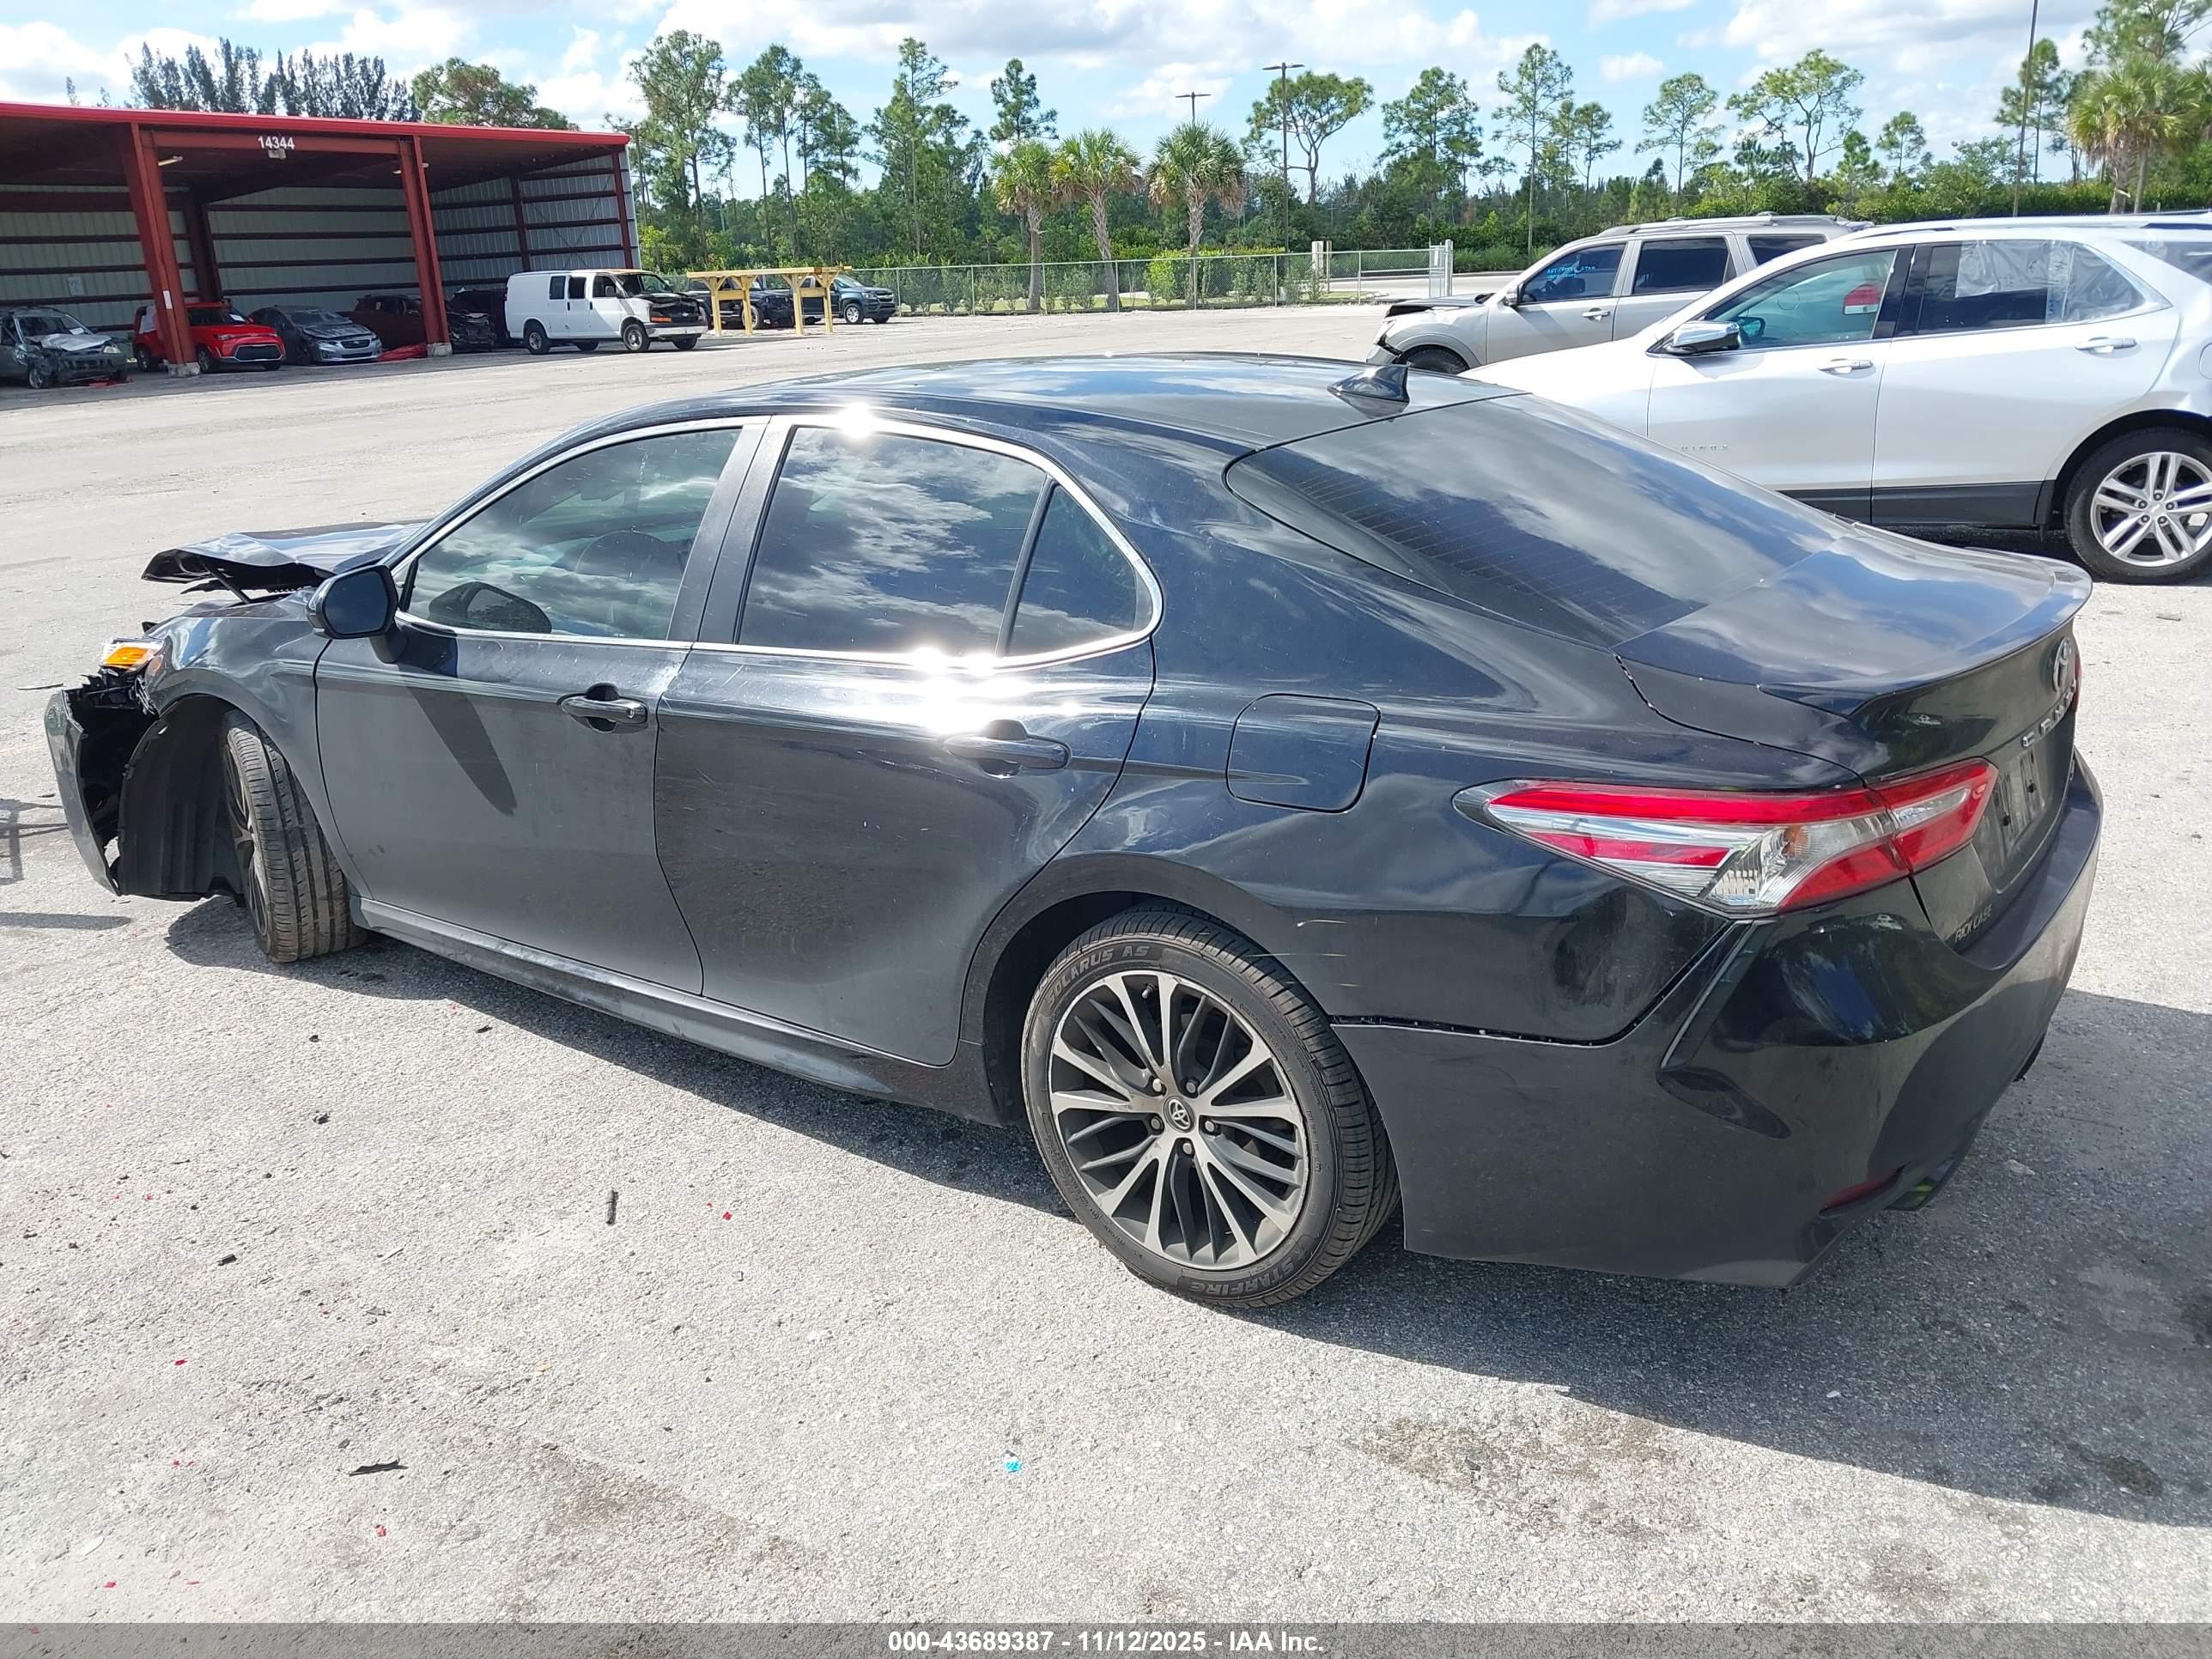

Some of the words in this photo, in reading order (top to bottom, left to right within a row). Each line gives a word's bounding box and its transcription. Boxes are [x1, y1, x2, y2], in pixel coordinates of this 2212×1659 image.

[258, 136, 295, 150] 14344
[1045, 947, 1114, 1006] SOLARUS
[1122, 945, 1151, 958] AS
[1190, 1257, 1295, 1296] STARFIRE
